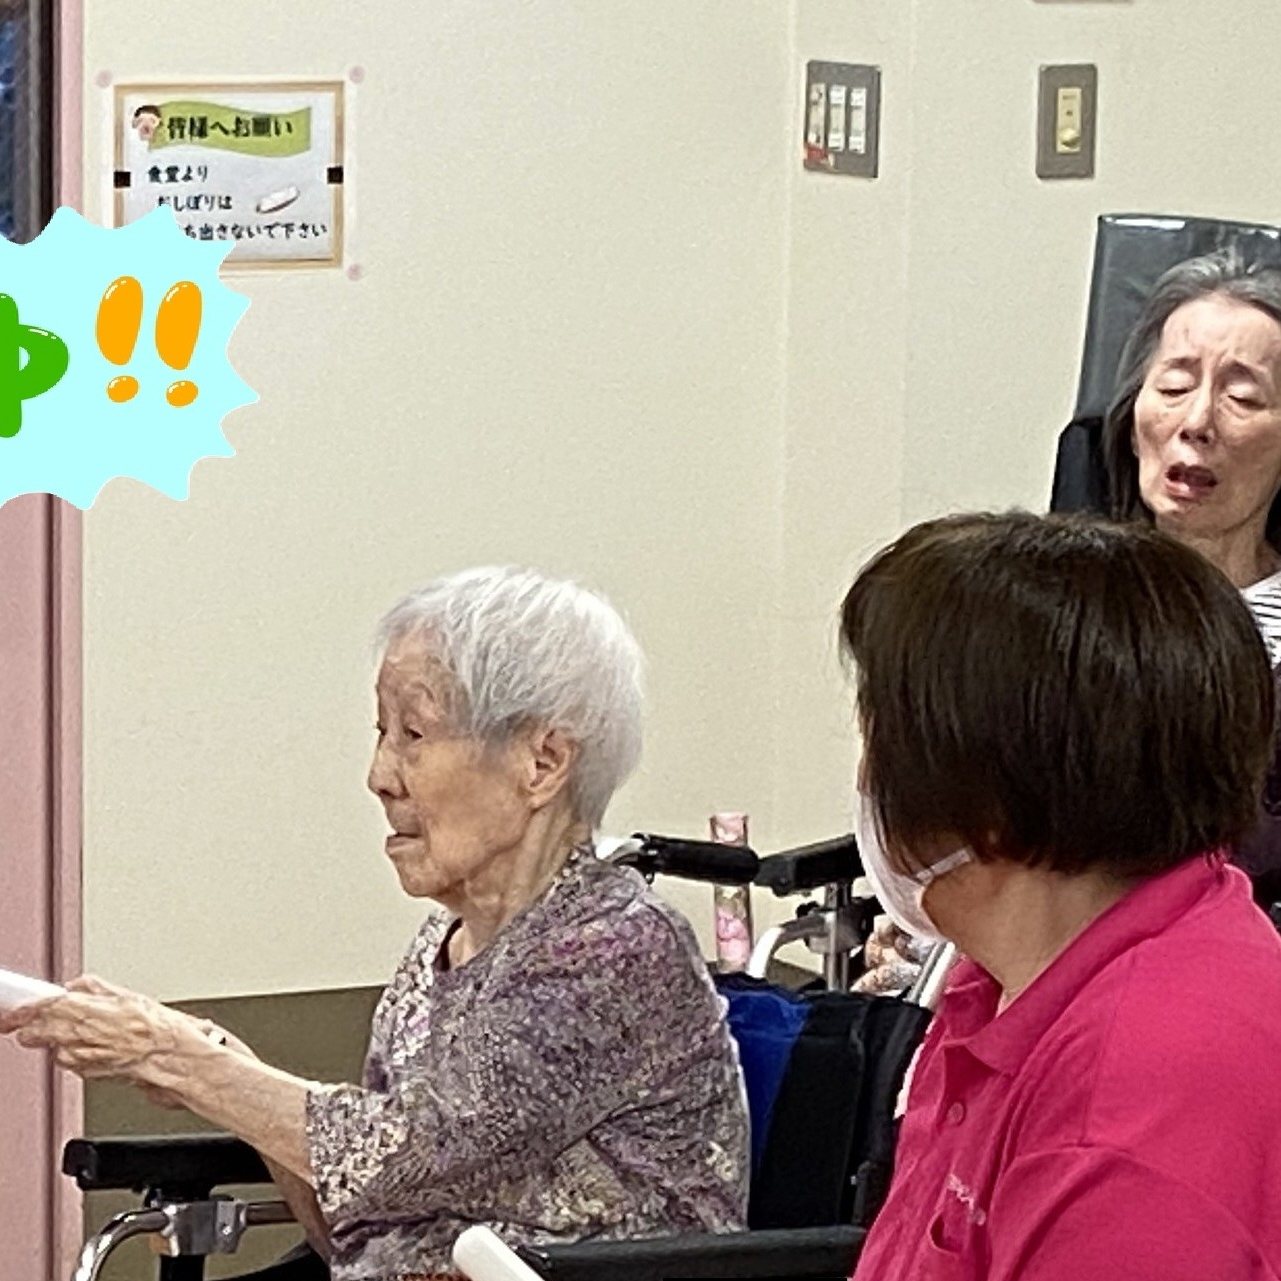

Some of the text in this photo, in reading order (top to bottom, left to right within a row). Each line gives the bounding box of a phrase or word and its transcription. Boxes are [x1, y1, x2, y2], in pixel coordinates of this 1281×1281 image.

[167, 116, 293, 141] 皆様へお願い
[147, 165, 209, 183] 食堂より
[181, 222, 328, 241] ち出さないで下さい
